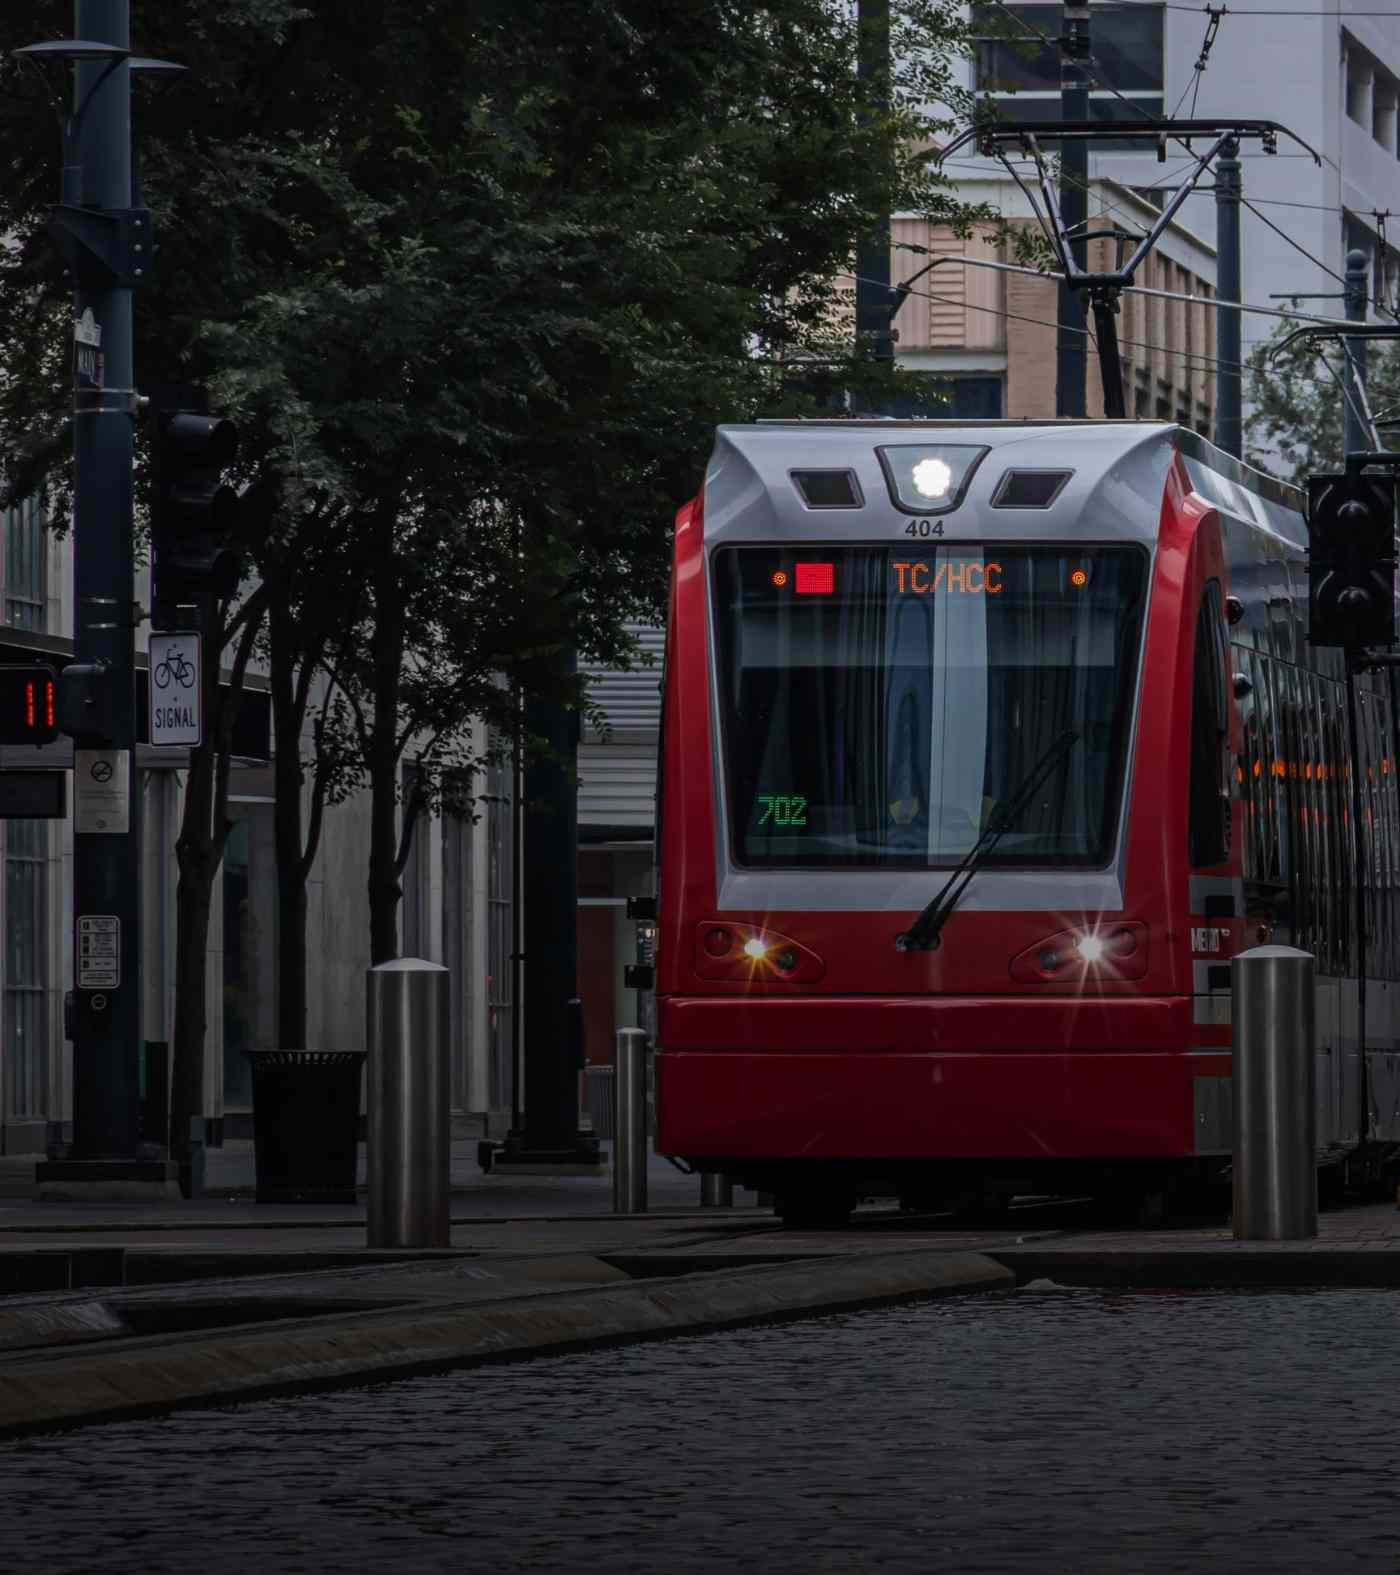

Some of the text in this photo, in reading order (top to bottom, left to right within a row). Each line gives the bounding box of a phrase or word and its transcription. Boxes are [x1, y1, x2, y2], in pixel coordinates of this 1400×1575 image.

[905, 519, 945, 537] 404
[892, 562, 1004, 593] TC/HCC
[155, 708, 196, 728] SIGNAL
[757, 796, 808, 825] 702
